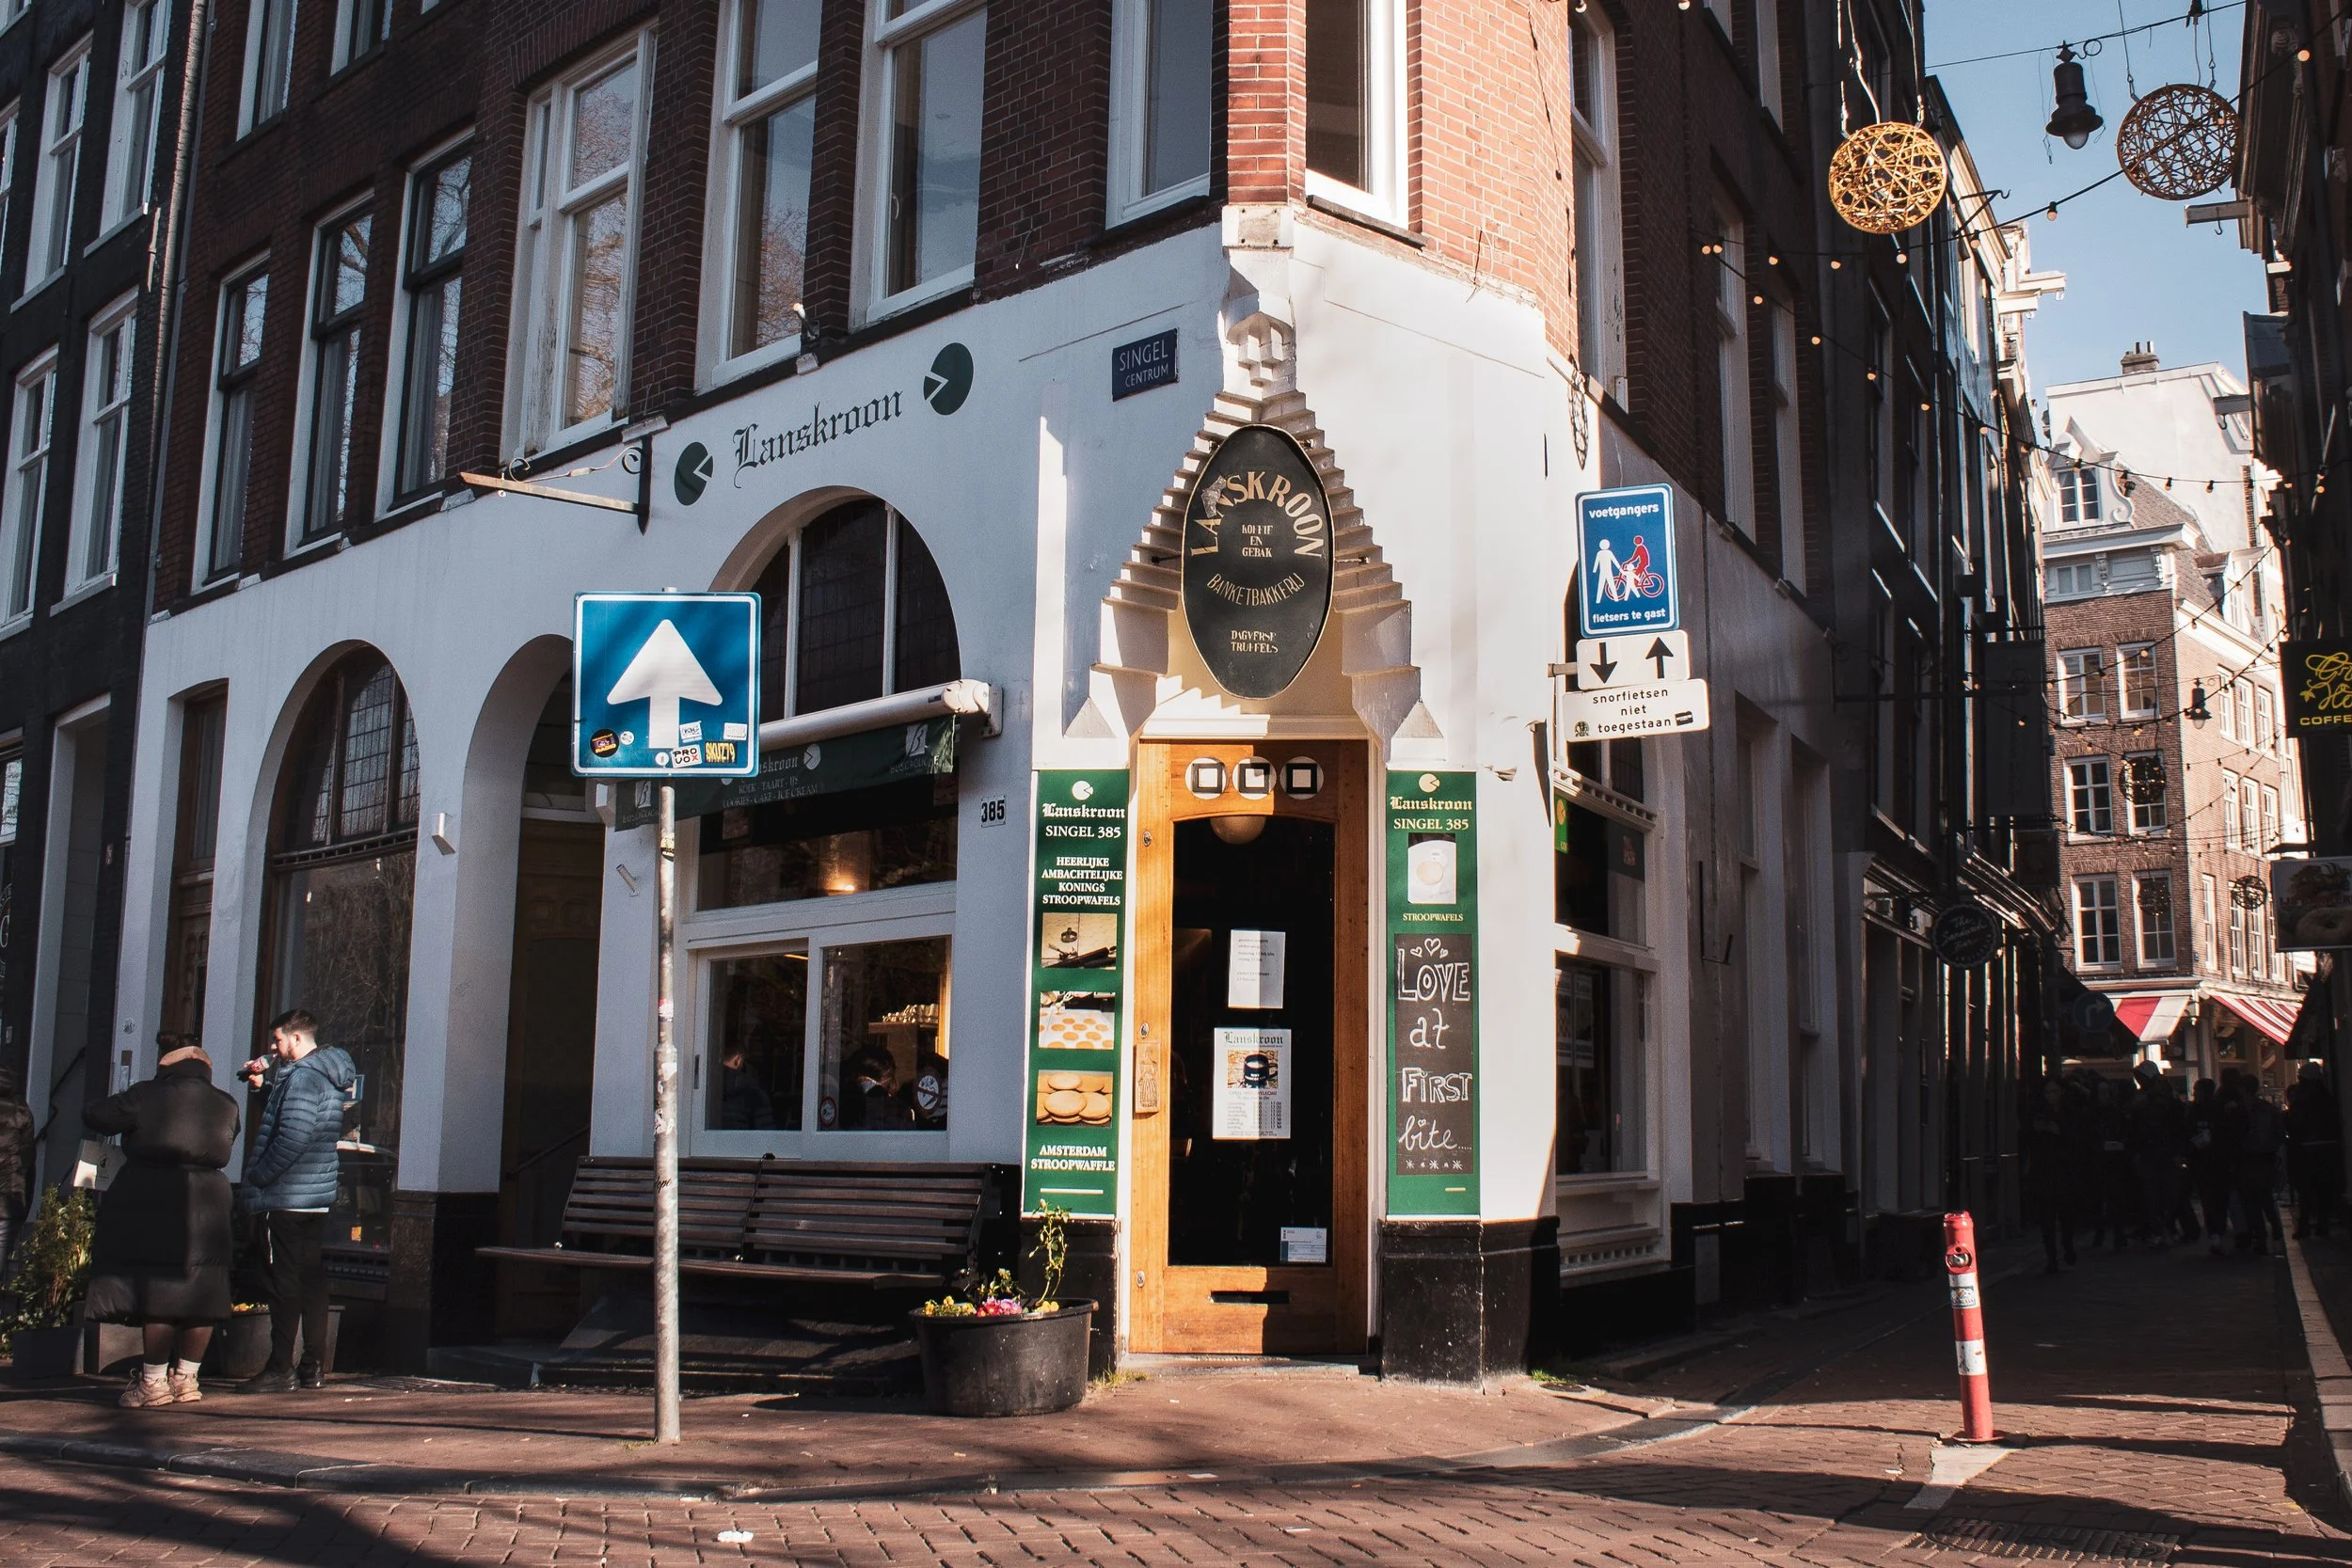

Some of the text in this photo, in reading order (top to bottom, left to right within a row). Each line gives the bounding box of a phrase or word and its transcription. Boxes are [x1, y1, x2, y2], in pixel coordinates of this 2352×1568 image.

[1120, 339, 1168, 372] SINGEL
[1125, 363, 1168, 388] CENTRUM
[733, 390, 903, 488] Lanskroon
[1589, 503, 1659, 519] voetgangers
[1250, 536, 1263, 546] EN
[1242, 546, 1273, 558] GEBAK
[1206, 572, 1305, 606] BANKETBAKKERIJ
[1593, 608, 1666, 624] fietsers te gast
[1231, 641, 1279, 654] TRUFFELS
[1593, 689, 1668, 705] snorfietsen
[1620, 705, 1647, 717] niet
[1597, 718, 1671, 734] toegestaan
[674, 747, 698, 758] PRO
[675, 753, 698, 765] VOX
[759, 755, 798, 774] skroon
[762, 778, 786, 791] TAART
[1390, 796, 1472, 811] Lanskroon
[981, 800, 1005, 822] 385
[1042, 803, 1125, 818] Lanskroon
[1393, 818, 1469, 831] SINGEL 385
[1045, 826, 1121, 839] SINGEL 385
[1057, 857, 1109, 868] HEERLIJKE
[1041, 869, 1122, 881] AMBACHTELIJKE
[1058, 882, 1105, 893] KONINGS
[1042, 895, 1120, 906] STROOPWAFELS
[1403, 912, 1464, 922] STROOPWAFELS
[1397, 947, 1470, 1002] LOVE
[1409, 1007, 1450, 1049] at
[1040, 1145, 1107, 1157] AMSTERDAM
[1030, 1158, 1116, 1171] STROOPWAFFLE
